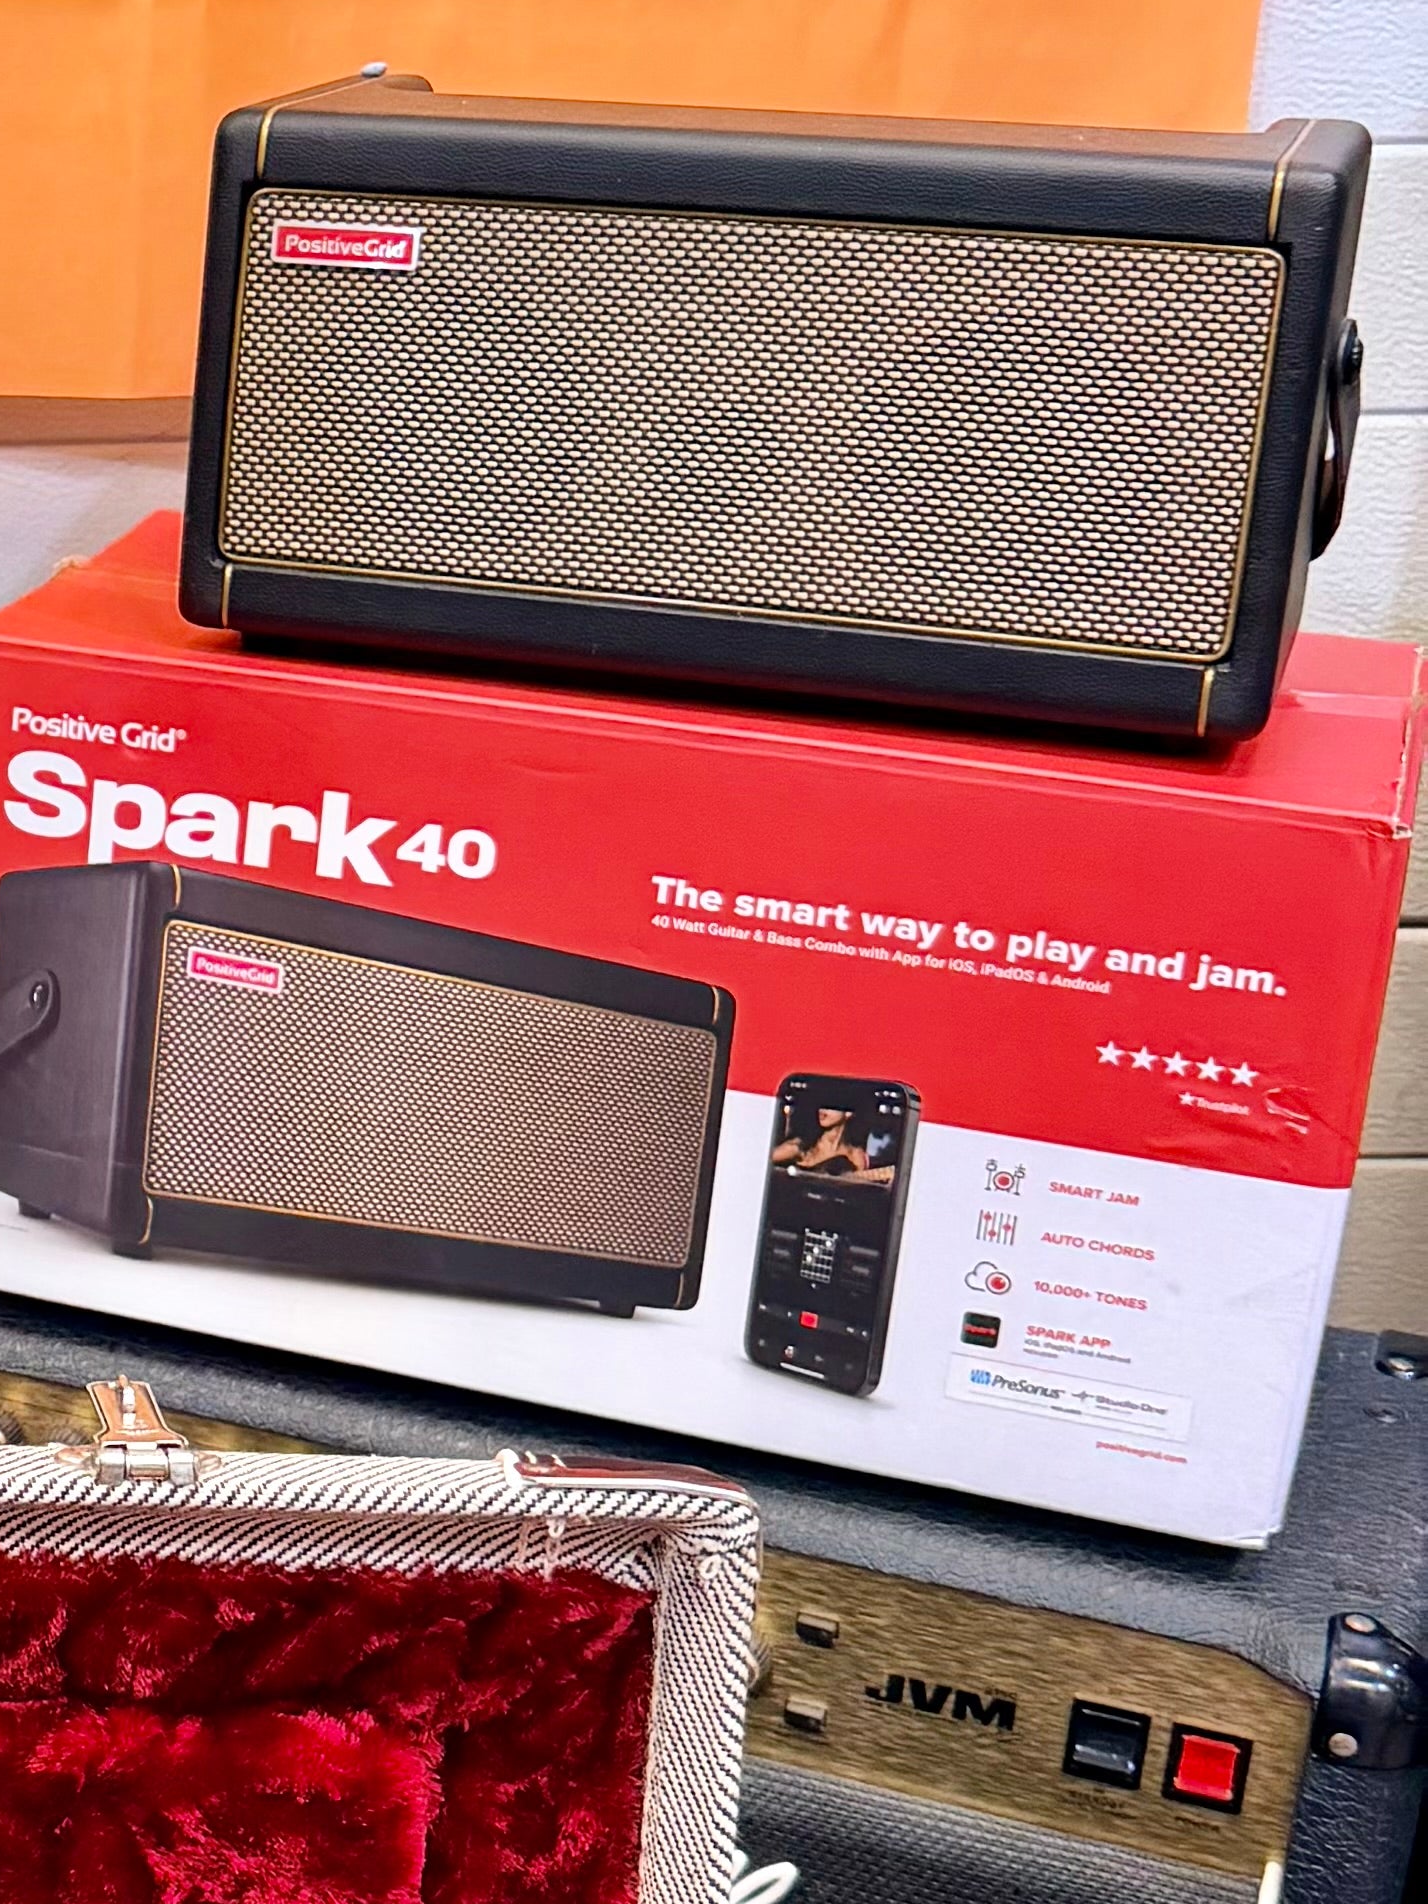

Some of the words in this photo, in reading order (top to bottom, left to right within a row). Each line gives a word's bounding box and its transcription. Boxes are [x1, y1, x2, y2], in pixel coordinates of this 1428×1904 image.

[284, 233, 408, 259] PositiveGrid
[11, 706, 116, 746] Positive
[3, 748, 398, 887] Spark
[396, 822, 498, 880] 40
[650, 874, 724, 912] The
[733, 893, 851, 932] smart
[860, 910, 945, 950] way
[953, 921, 996, 952] to
[1005, 930, 1096, 973] play
[1104, 951, 1186, 981] and
[1188, 954, 1288, 996] jam.
[650, 913, 670, 929] 40
[672, 916, 706, 935] Watt
[707, 922, 752, 941] Guitar
[753, 928, 764, 943] &
[766, 930, 802, 948] Bass
[804, 935, 856, 956] Combo
[858, 944, 890, 961] with
[892, 949, 921, 968] App
[924, 952, 946, 970] for
[980, 962, 1036, 983] iPadOS
[1037, 970, 1048, 985] &
[1050, 973, 1112, 995] Android
[195, 956, 275, 984] PositiveGrid
[1048, 1180, 1104, 1200] SMART
[1105, 1190, 1140, 1207] JAM
[1040, 1231, 1085, 1248] AUTO
[1087, 1239, 1156, 1262] CHORDS
[1034, 1279, 1092, 1300] 10,000+
[1094, 1290, 1148, 1311] TONES
[1026, 1324, 1076, 1344] SPARK
[1079, 1334, 1112, 1349] APP
[991, 1373, 1062, 1400] PreSonus
[863, 1673, 1017, 1731] JVM
